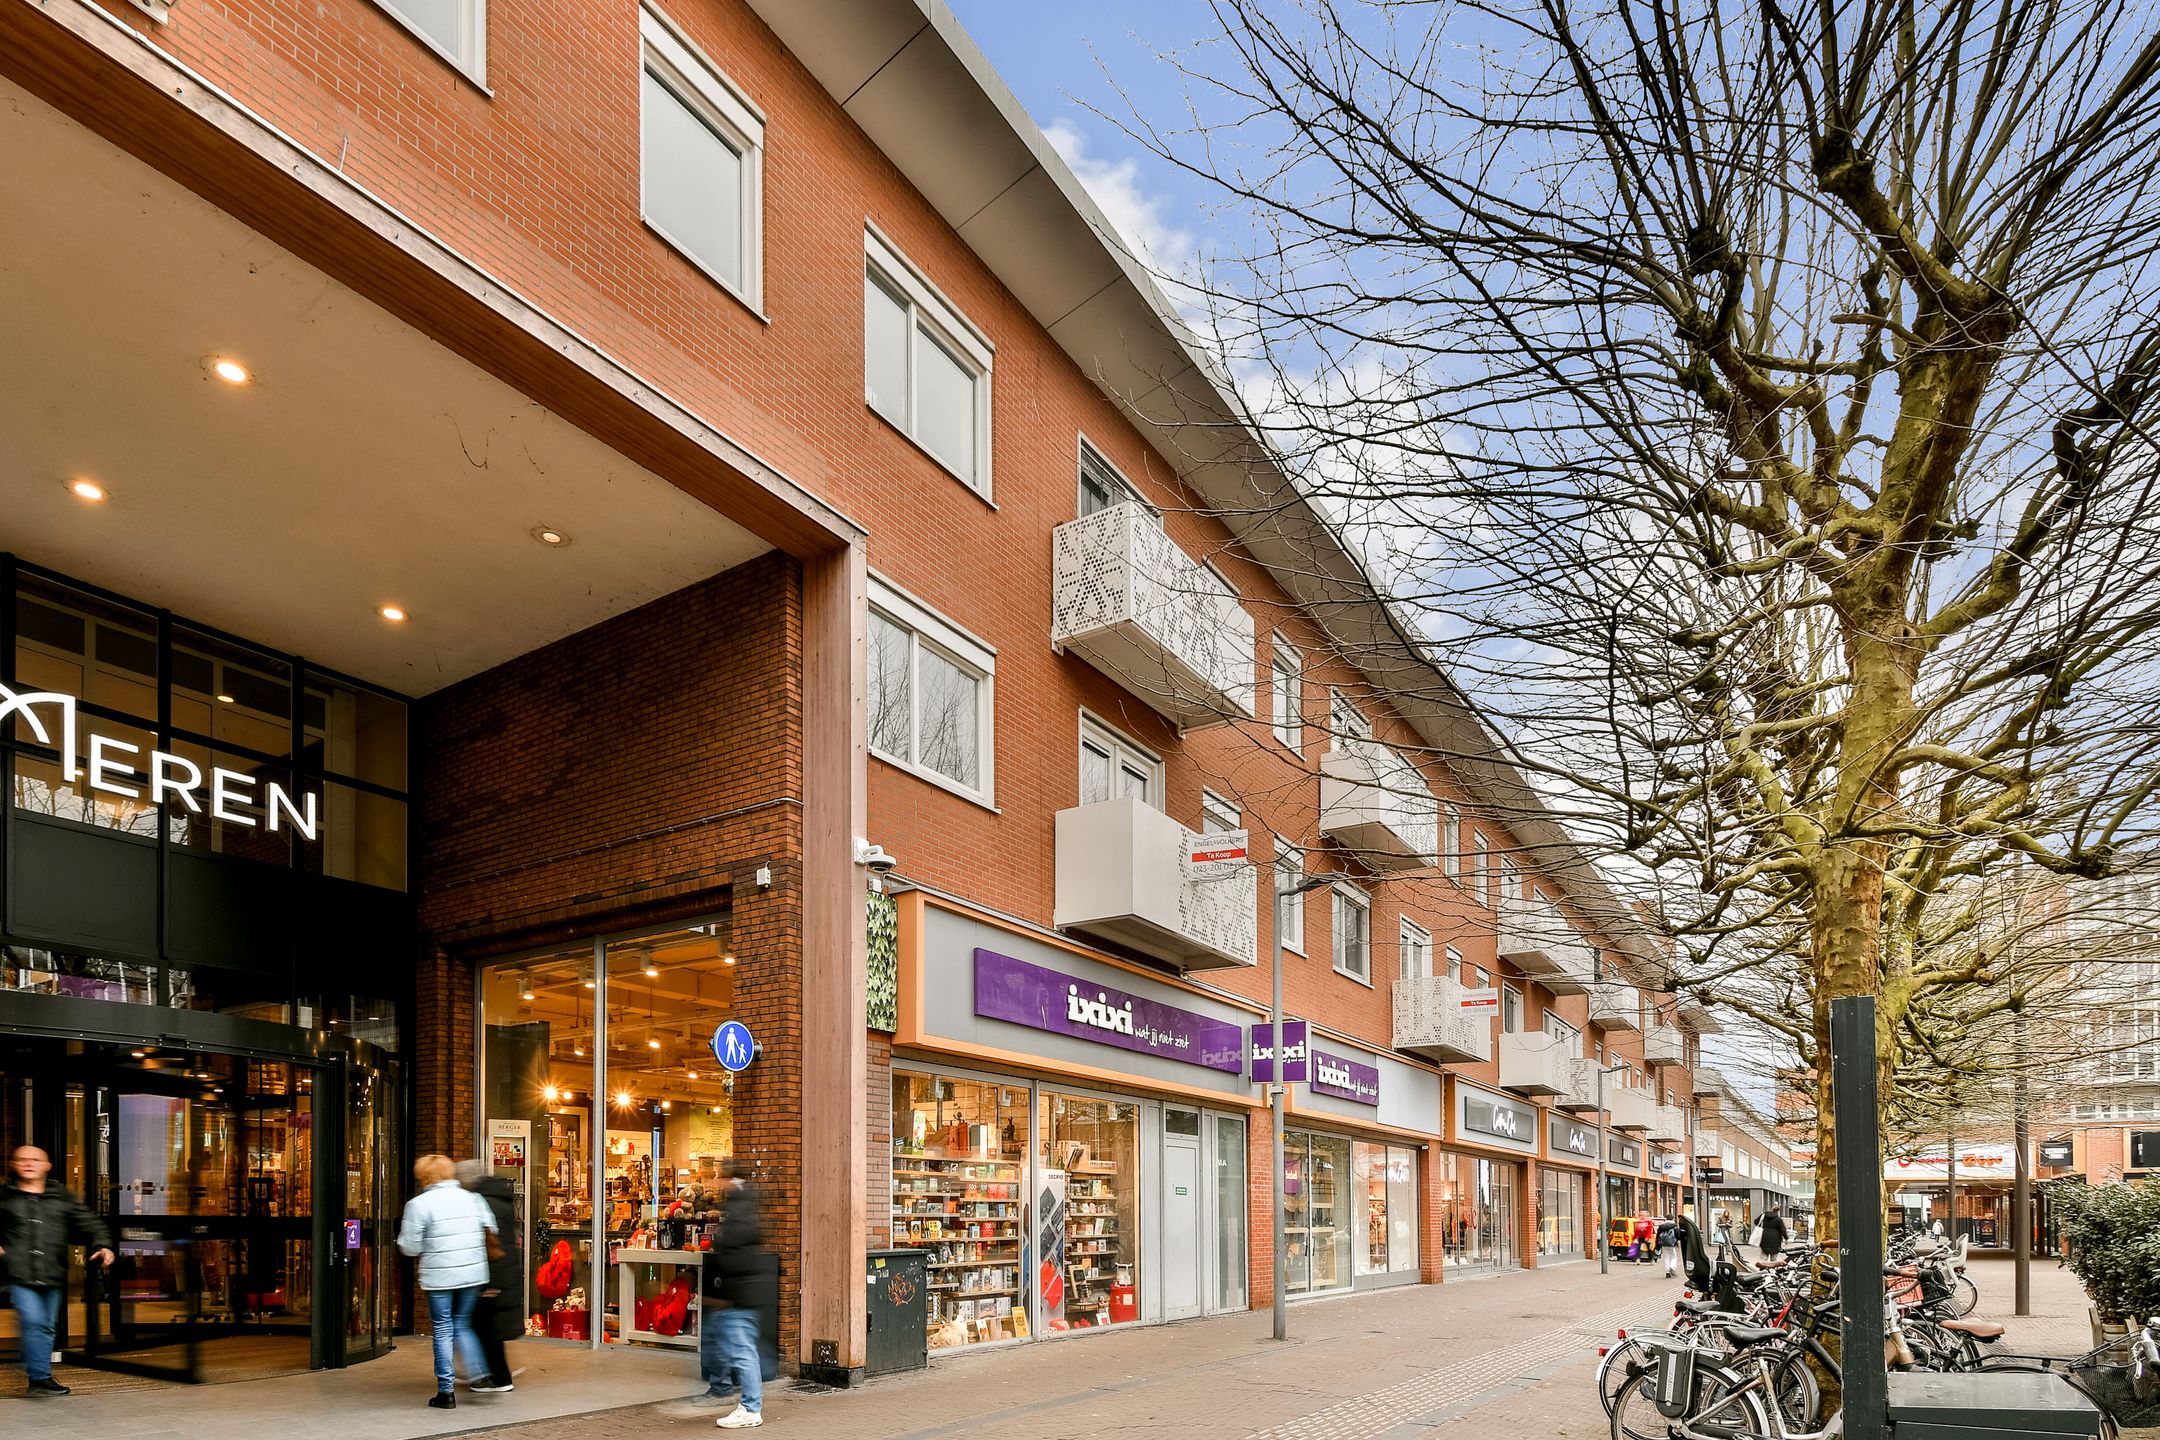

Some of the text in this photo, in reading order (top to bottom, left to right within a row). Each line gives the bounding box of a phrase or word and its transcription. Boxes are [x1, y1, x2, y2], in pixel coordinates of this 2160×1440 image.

[1067, 984, 1134, 1035] ixixi
[1134, 1024, 1150, 1040] wat
[1158, 1030, 1174, 1046] niet
[1174, 1034, 1190, 1050] ziet
[1252, 1040, 1306, 1061] ixxi
[1317, 1056, 1350, 1090] ixixi
[349, 1229, 355, 1240] 4
